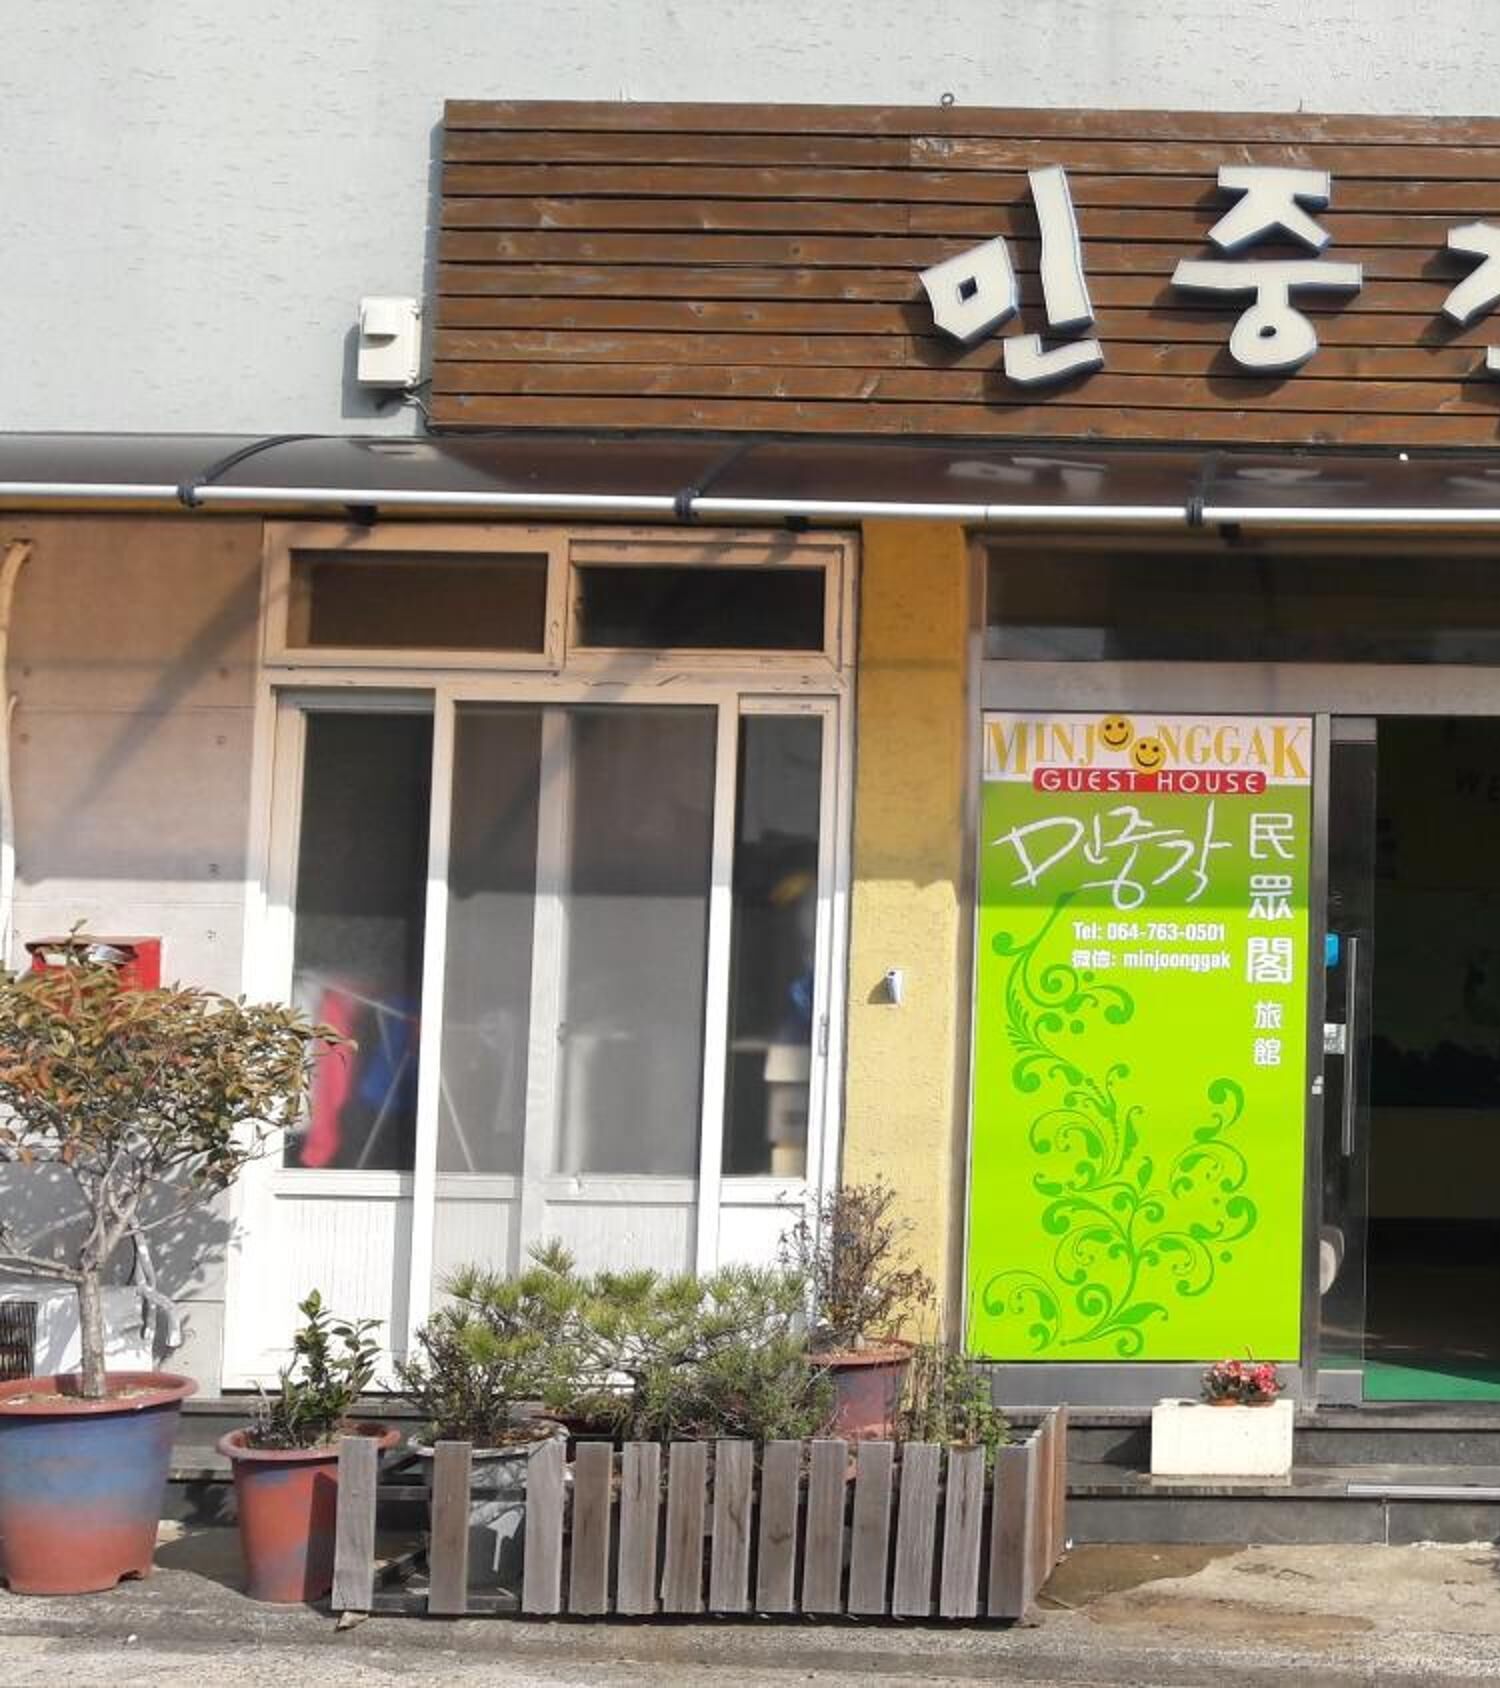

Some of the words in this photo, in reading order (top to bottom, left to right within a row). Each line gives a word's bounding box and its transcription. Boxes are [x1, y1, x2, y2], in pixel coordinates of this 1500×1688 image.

[1040, 770, 1137, 792] GUEST
[1157, 771, 1260, 794] HOUSE
[1072, 922, 1102, 941] Tel:
[1106, 922, 1226, 942] 064-763-0501
[1123, 949, 1232, 973] minjoonggak
